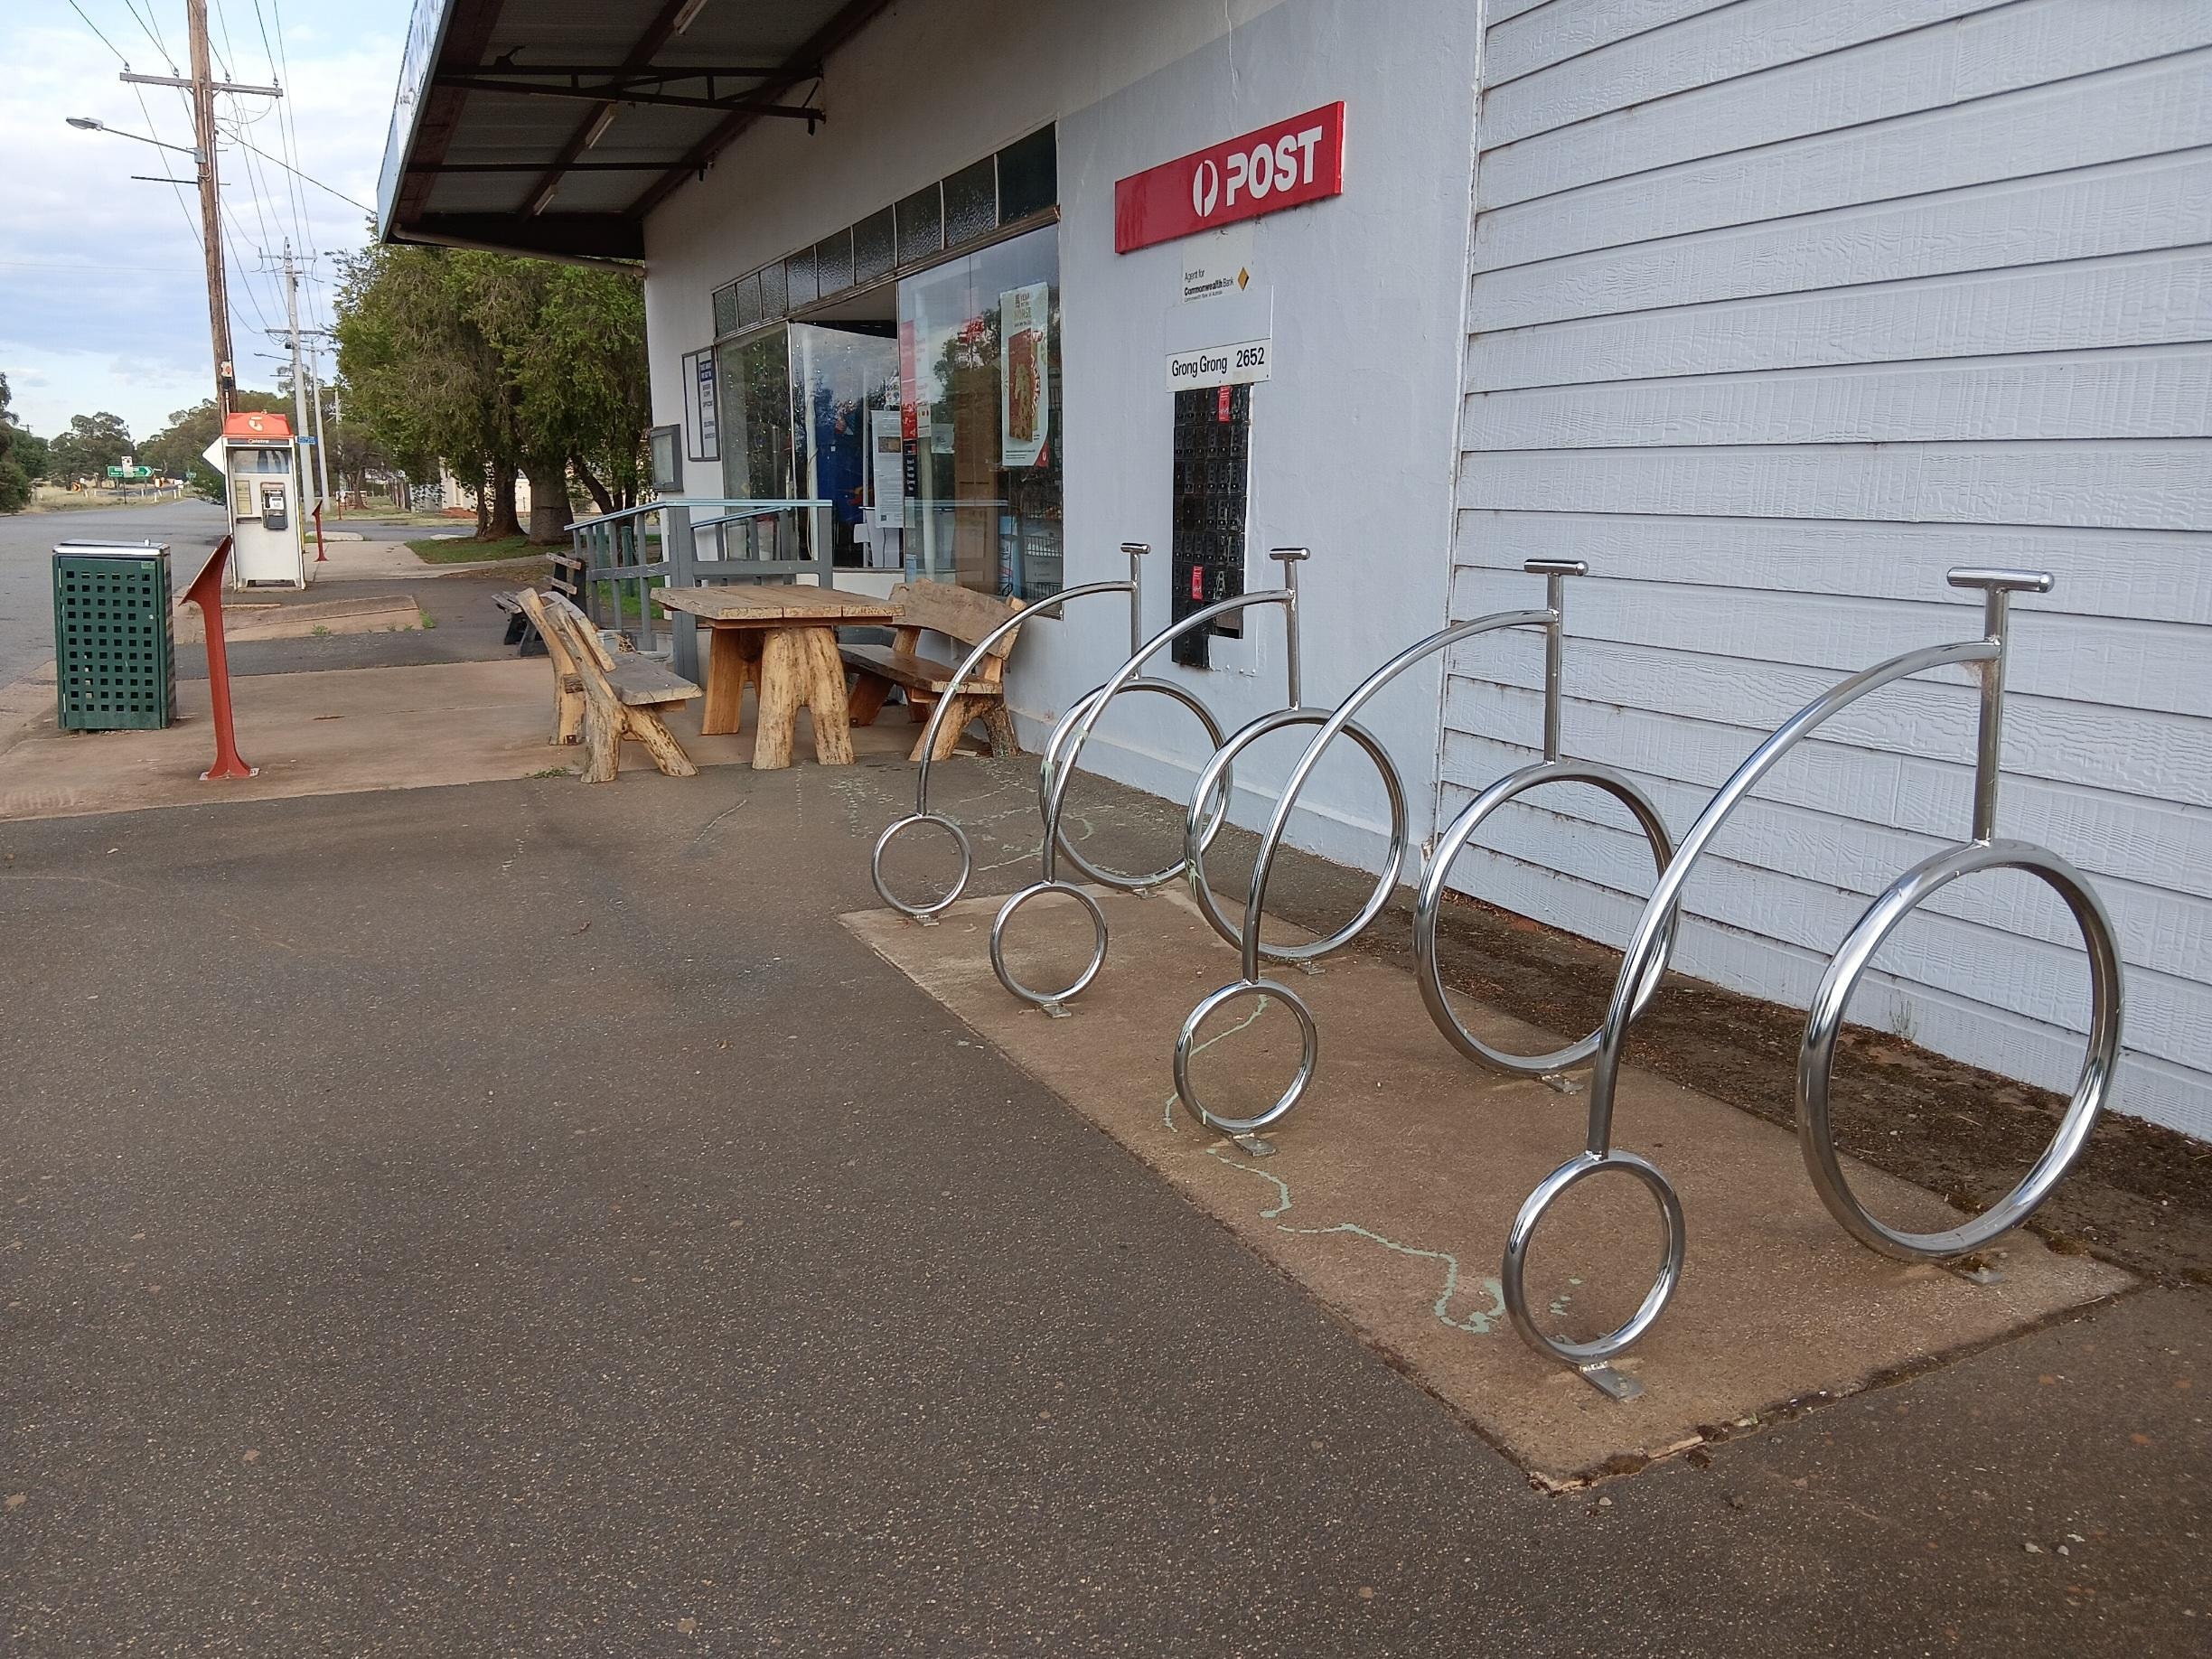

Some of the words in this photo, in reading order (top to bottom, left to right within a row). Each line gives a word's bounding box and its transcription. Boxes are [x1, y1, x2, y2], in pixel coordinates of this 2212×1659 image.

[1226, 126, 1323, 206] POST
[1184, 280, 1223, 296] Commonwealth
[1223, 276, 1234, 287] Bank
[1185, 270, 1197, 283] Agent
[1172, 360, 1198, 378] Grong
[1199, 355, 1228, 375] Grong
[1236, 347, 1264, 368] 2652
